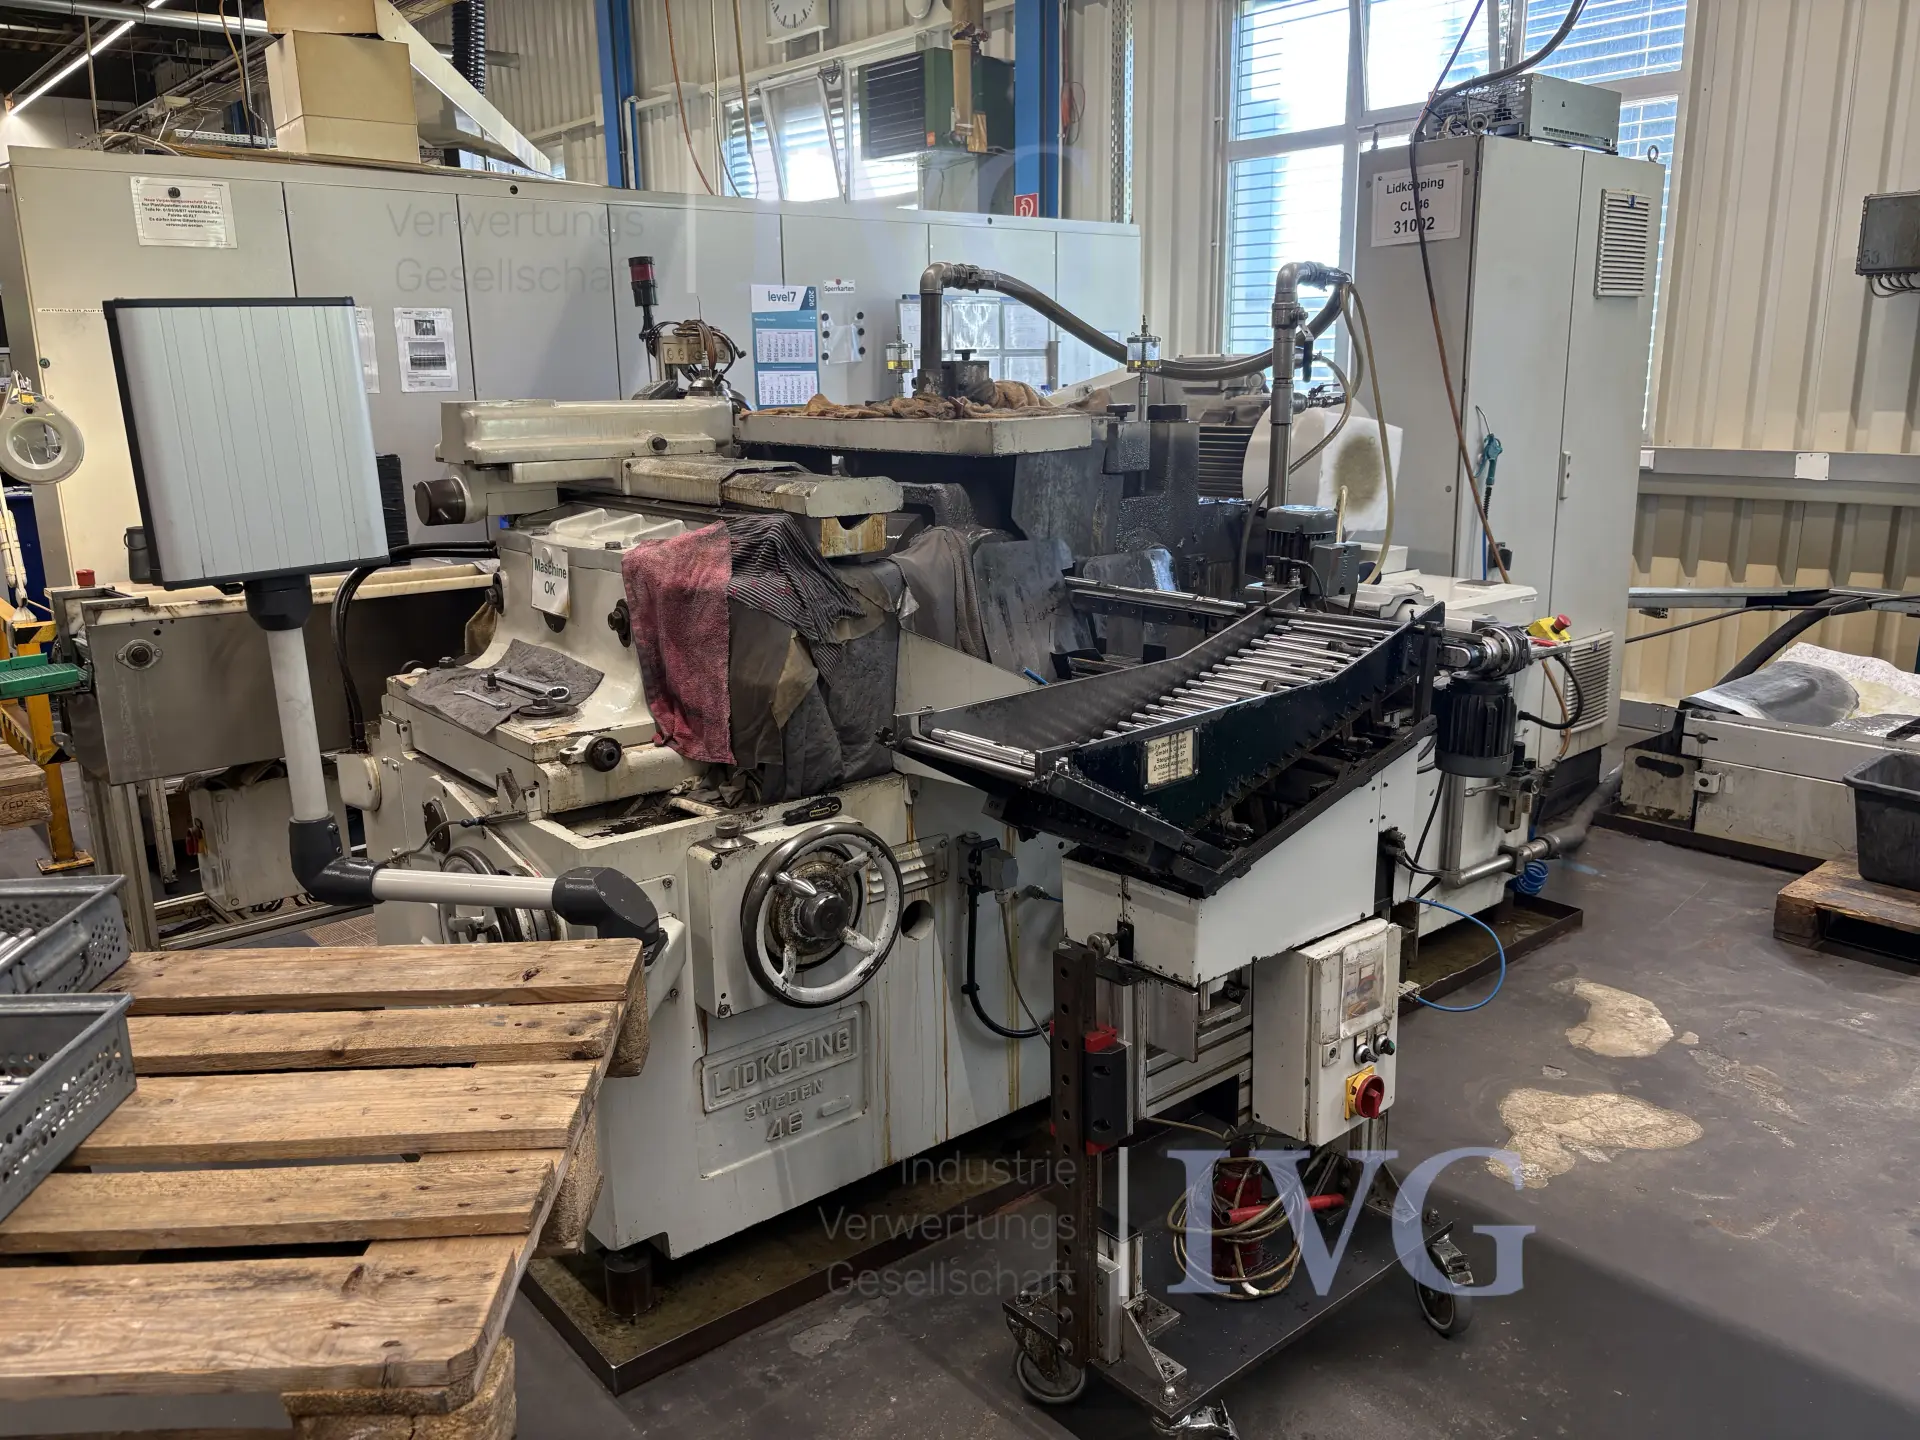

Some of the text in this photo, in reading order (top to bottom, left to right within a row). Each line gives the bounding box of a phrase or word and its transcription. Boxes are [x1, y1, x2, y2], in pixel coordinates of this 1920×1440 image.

[768, 290, 796, 302] level7
[534, 558, 567, 579] Maschine
[544, 581, 556, 596] OK
[714, 1027, 850, 1098] LIDKÖPING
[744, 1078, 824, 1121] SWEDEN
